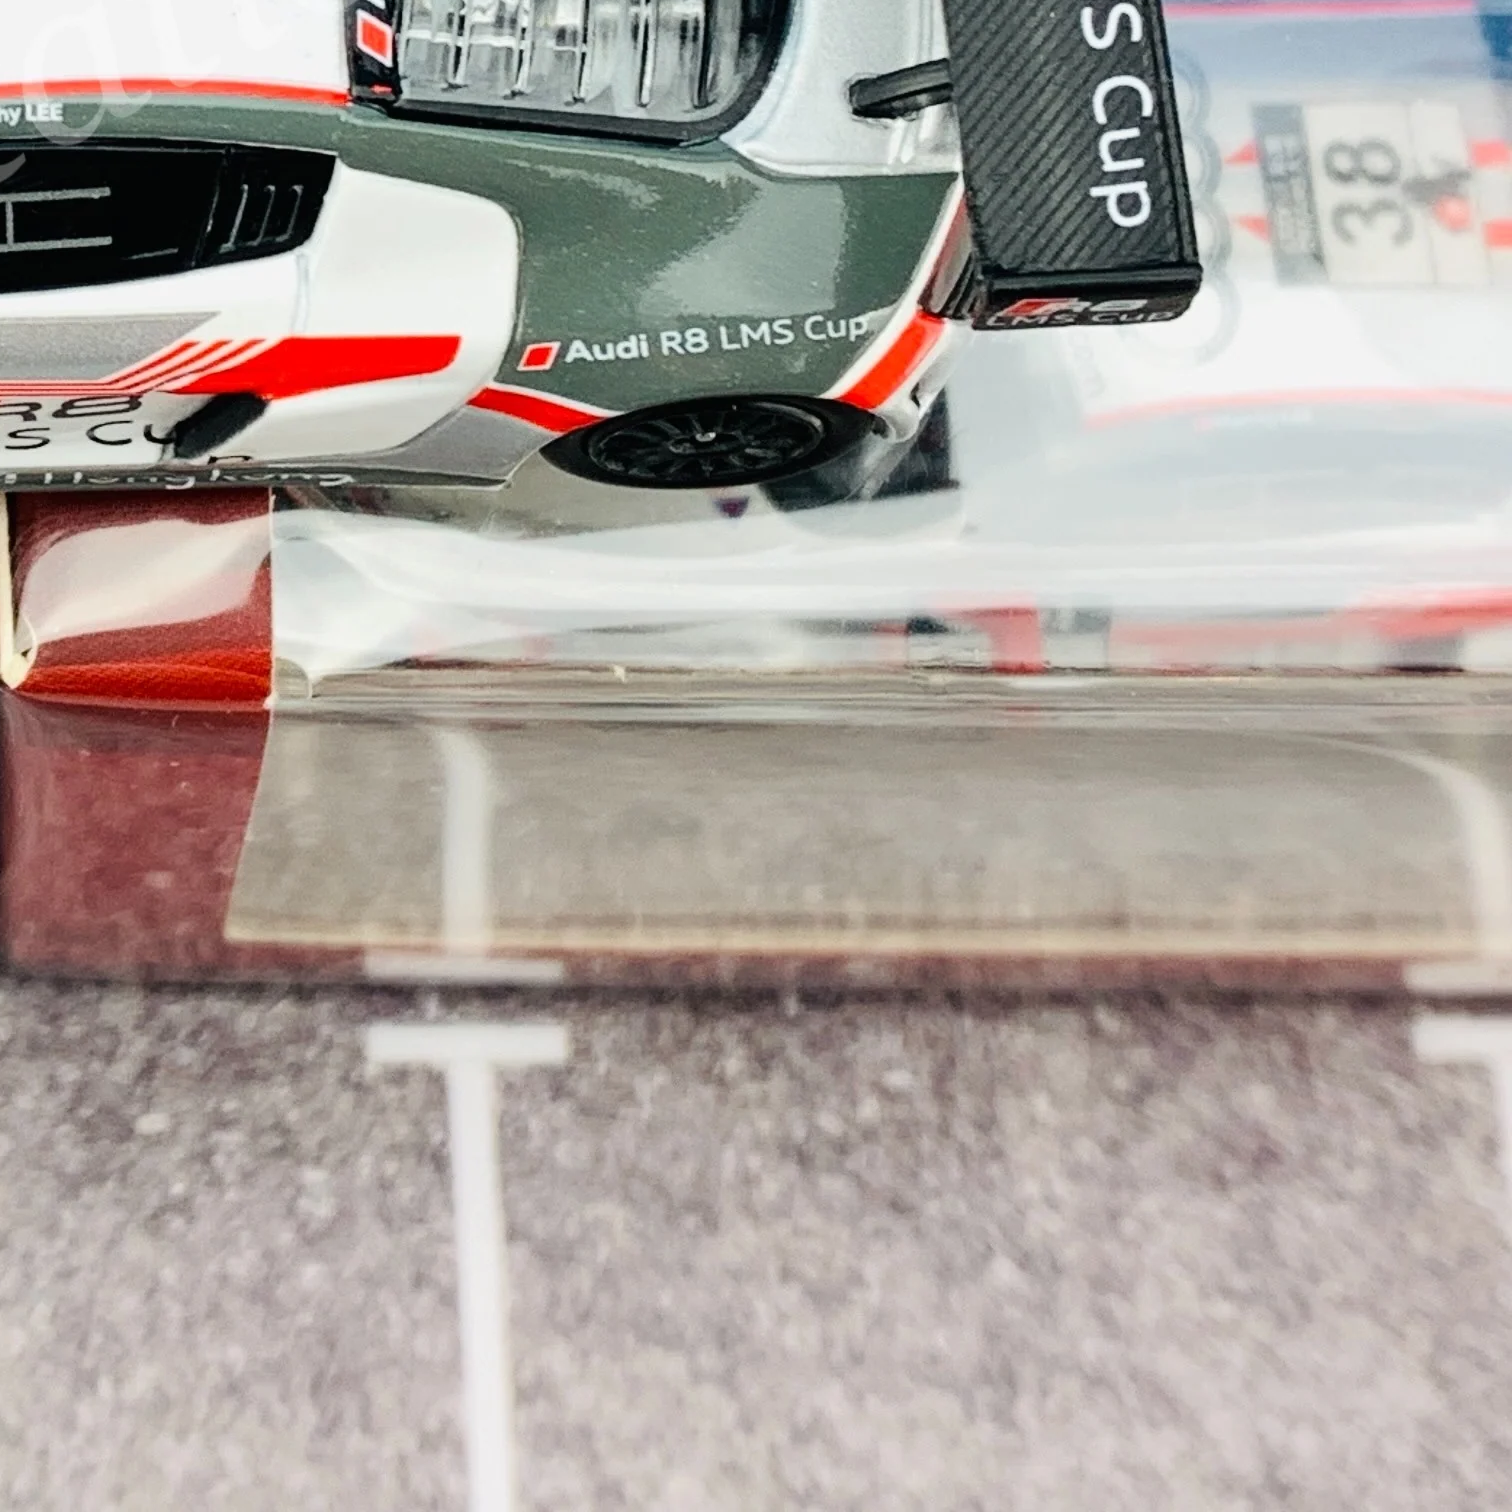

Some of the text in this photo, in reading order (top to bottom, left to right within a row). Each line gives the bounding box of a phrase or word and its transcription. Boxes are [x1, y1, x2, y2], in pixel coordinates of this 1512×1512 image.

[24, 101, 65, 123] LEE
[1089, 73, 1154, 230] Cup
[564, 314, 868, 364] Audi R8 LMS Cup
